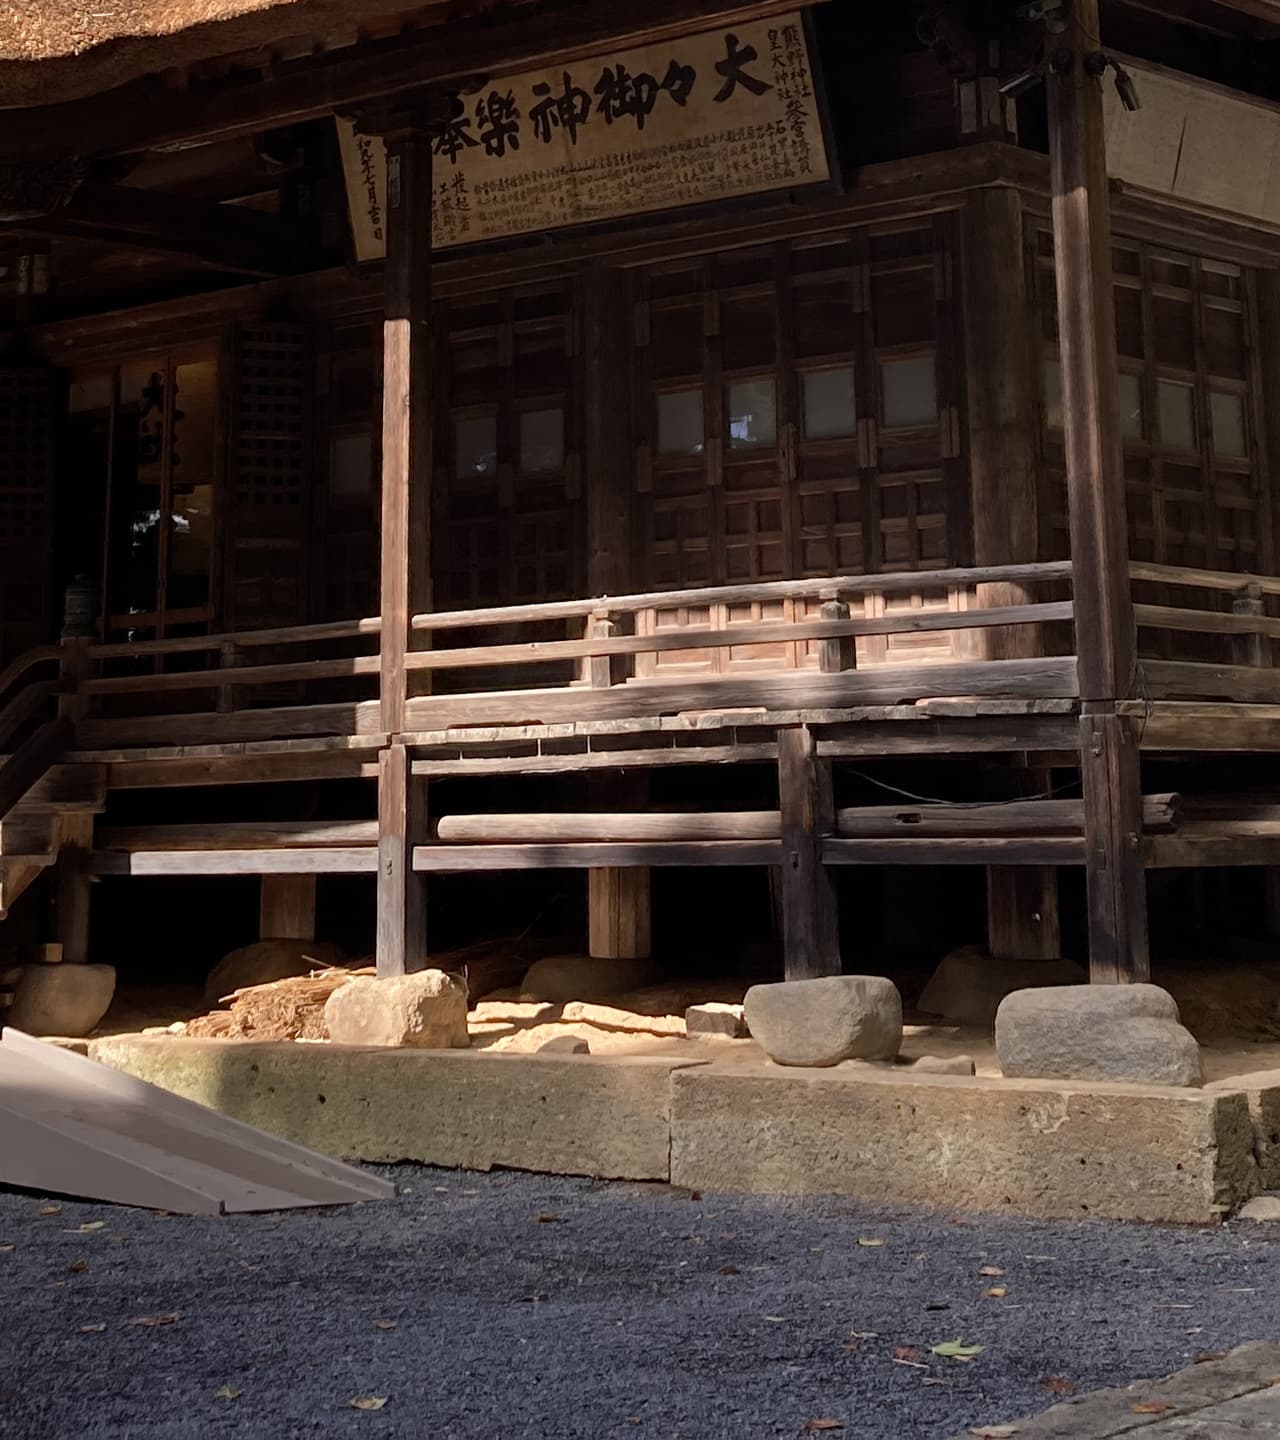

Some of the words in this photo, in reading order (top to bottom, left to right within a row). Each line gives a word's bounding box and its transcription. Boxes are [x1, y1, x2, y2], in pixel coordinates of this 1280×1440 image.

[420, 33, 775, 165] 大々御神樂奉
[353, 122, 383, 241] 和九年七月吉日
